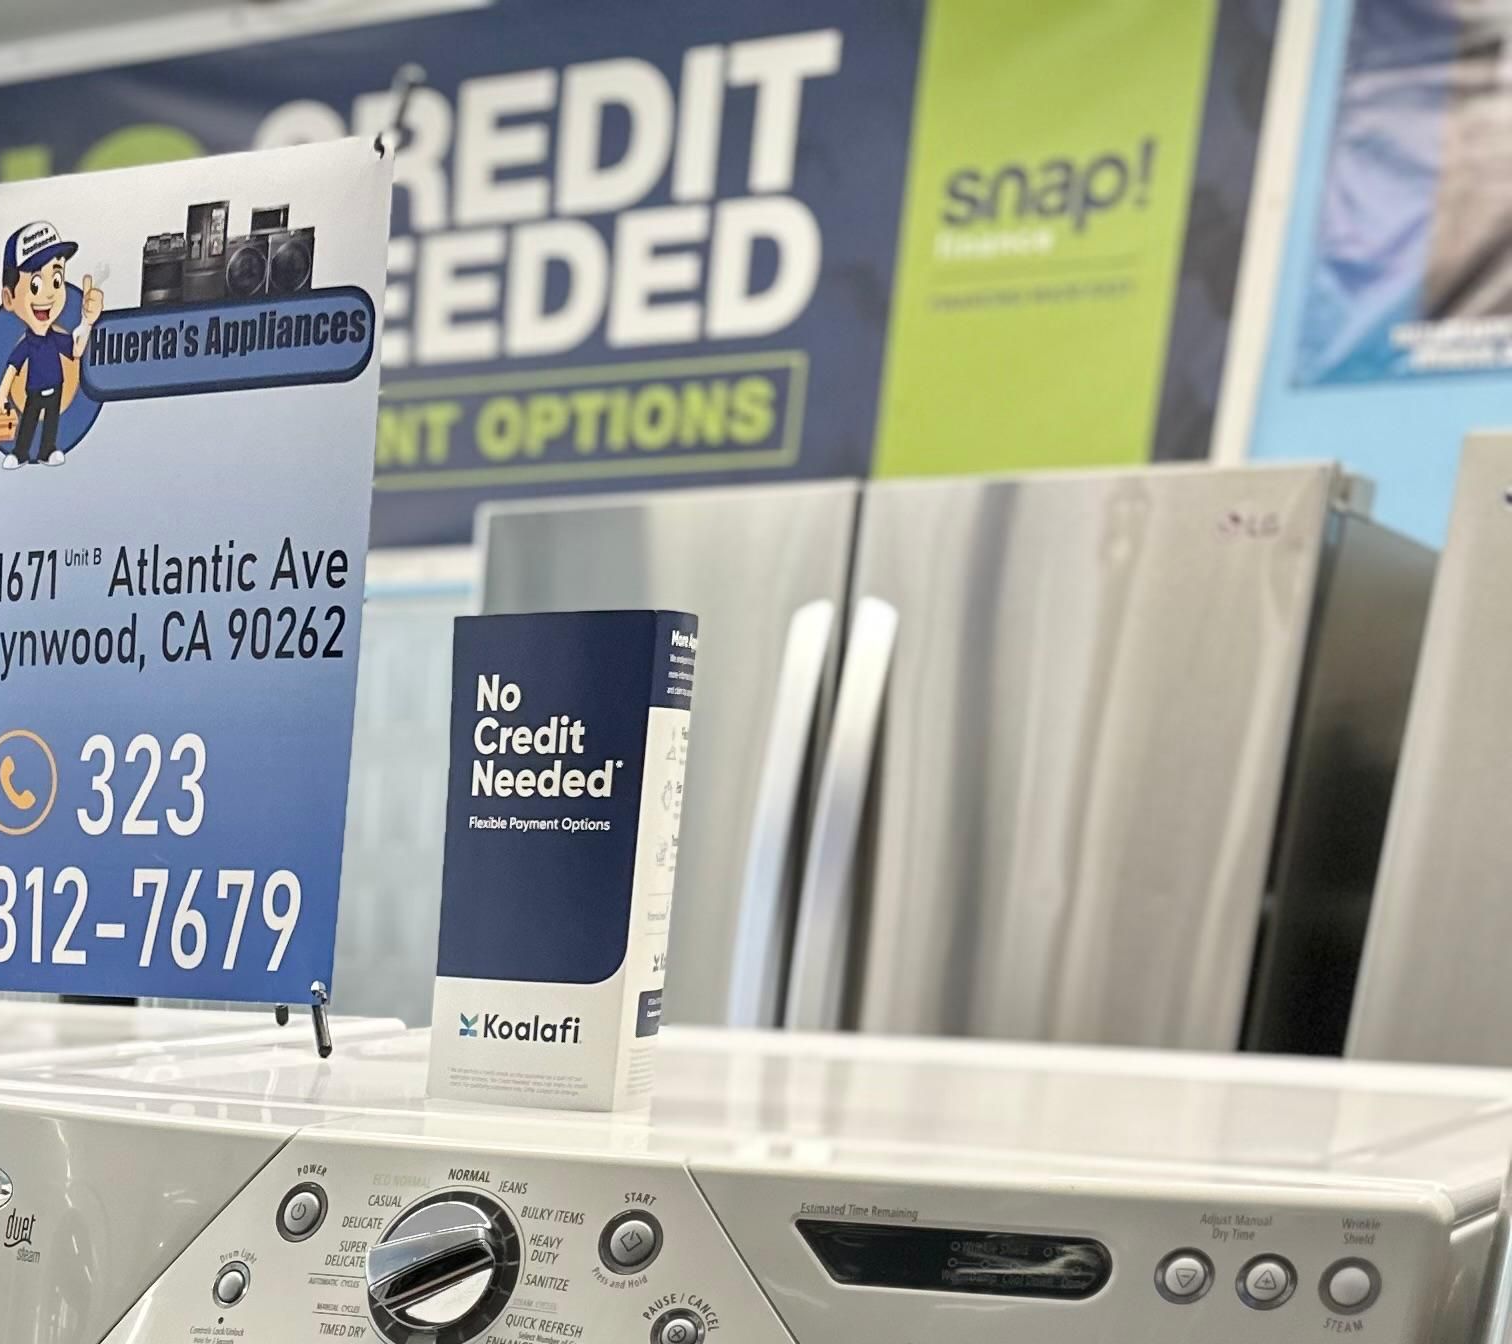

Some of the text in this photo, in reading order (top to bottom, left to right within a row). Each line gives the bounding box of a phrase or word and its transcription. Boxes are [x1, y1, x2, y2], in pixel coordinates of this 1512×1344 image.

[941, 137, 1159, 236] snap!
[89, 307, 367, 367] Huerta's Appliances
[475, 375, 777, 462] OPTIONS
[64, 548, 89, 568] Unit
[93, 547, 103, 566] B
[107, 539, 258, 598] Atlantic
[269, 536, 349, 591] Ave
[161, 609, 212, 662] CA
[227, 605, 347, 661] 90262
[475, 673, 522, 713] No
[473, 715, 585, 756] Credit
[76, 732, 208, 837] 323
[469, 815, 611, 834] Flexible Payment Options
[483, 1012, 582, 1045] Koalafi
[297, 1163, 328, 1177] POWER
[448, 1168, 491, 1183] NORMAL
[498, 1180, 528, 1195] JEANS
[368, 1194, 402, 1208] CASUAL
[624, 1192, 657, 1207] START
[521, 1206, 585, 1226] BULKY ITEMS
[800, 1202, 919, 1222] Estimated Time Remaining
[4, 1207, 36, 1242] duet
[341, 1216, 384, 1230] DELICATE
[1200, 1213, 1273, 1229] Adjust Manual
[1342, 1217, 1382, 1231] Wrinkle
[529, 1234, 563, 1250] HEAVY
[1212, 1228, 1255, 1242] Dry Time
[1343, 1232, 1376, 1245] Shield
[339, 1240, 368, 1253] SUPER
[16, 1247, 41, 1264] steam
[324, 1254, 366, 1269] DELICATE
[530, 1249, 560, 1265] DUTY
[524, 1273, 570, 1292] SANITIZE
[642, 1293, 677, 1320] PAUSE
[688, 1294, 720, 1332] CANCEL
[319, 1322, 367, 1339] TIMED DRY
[505, 1313, 584, 1339] QUICK REFRESH
[1323, 1317, 1364, 1334] STEAM
